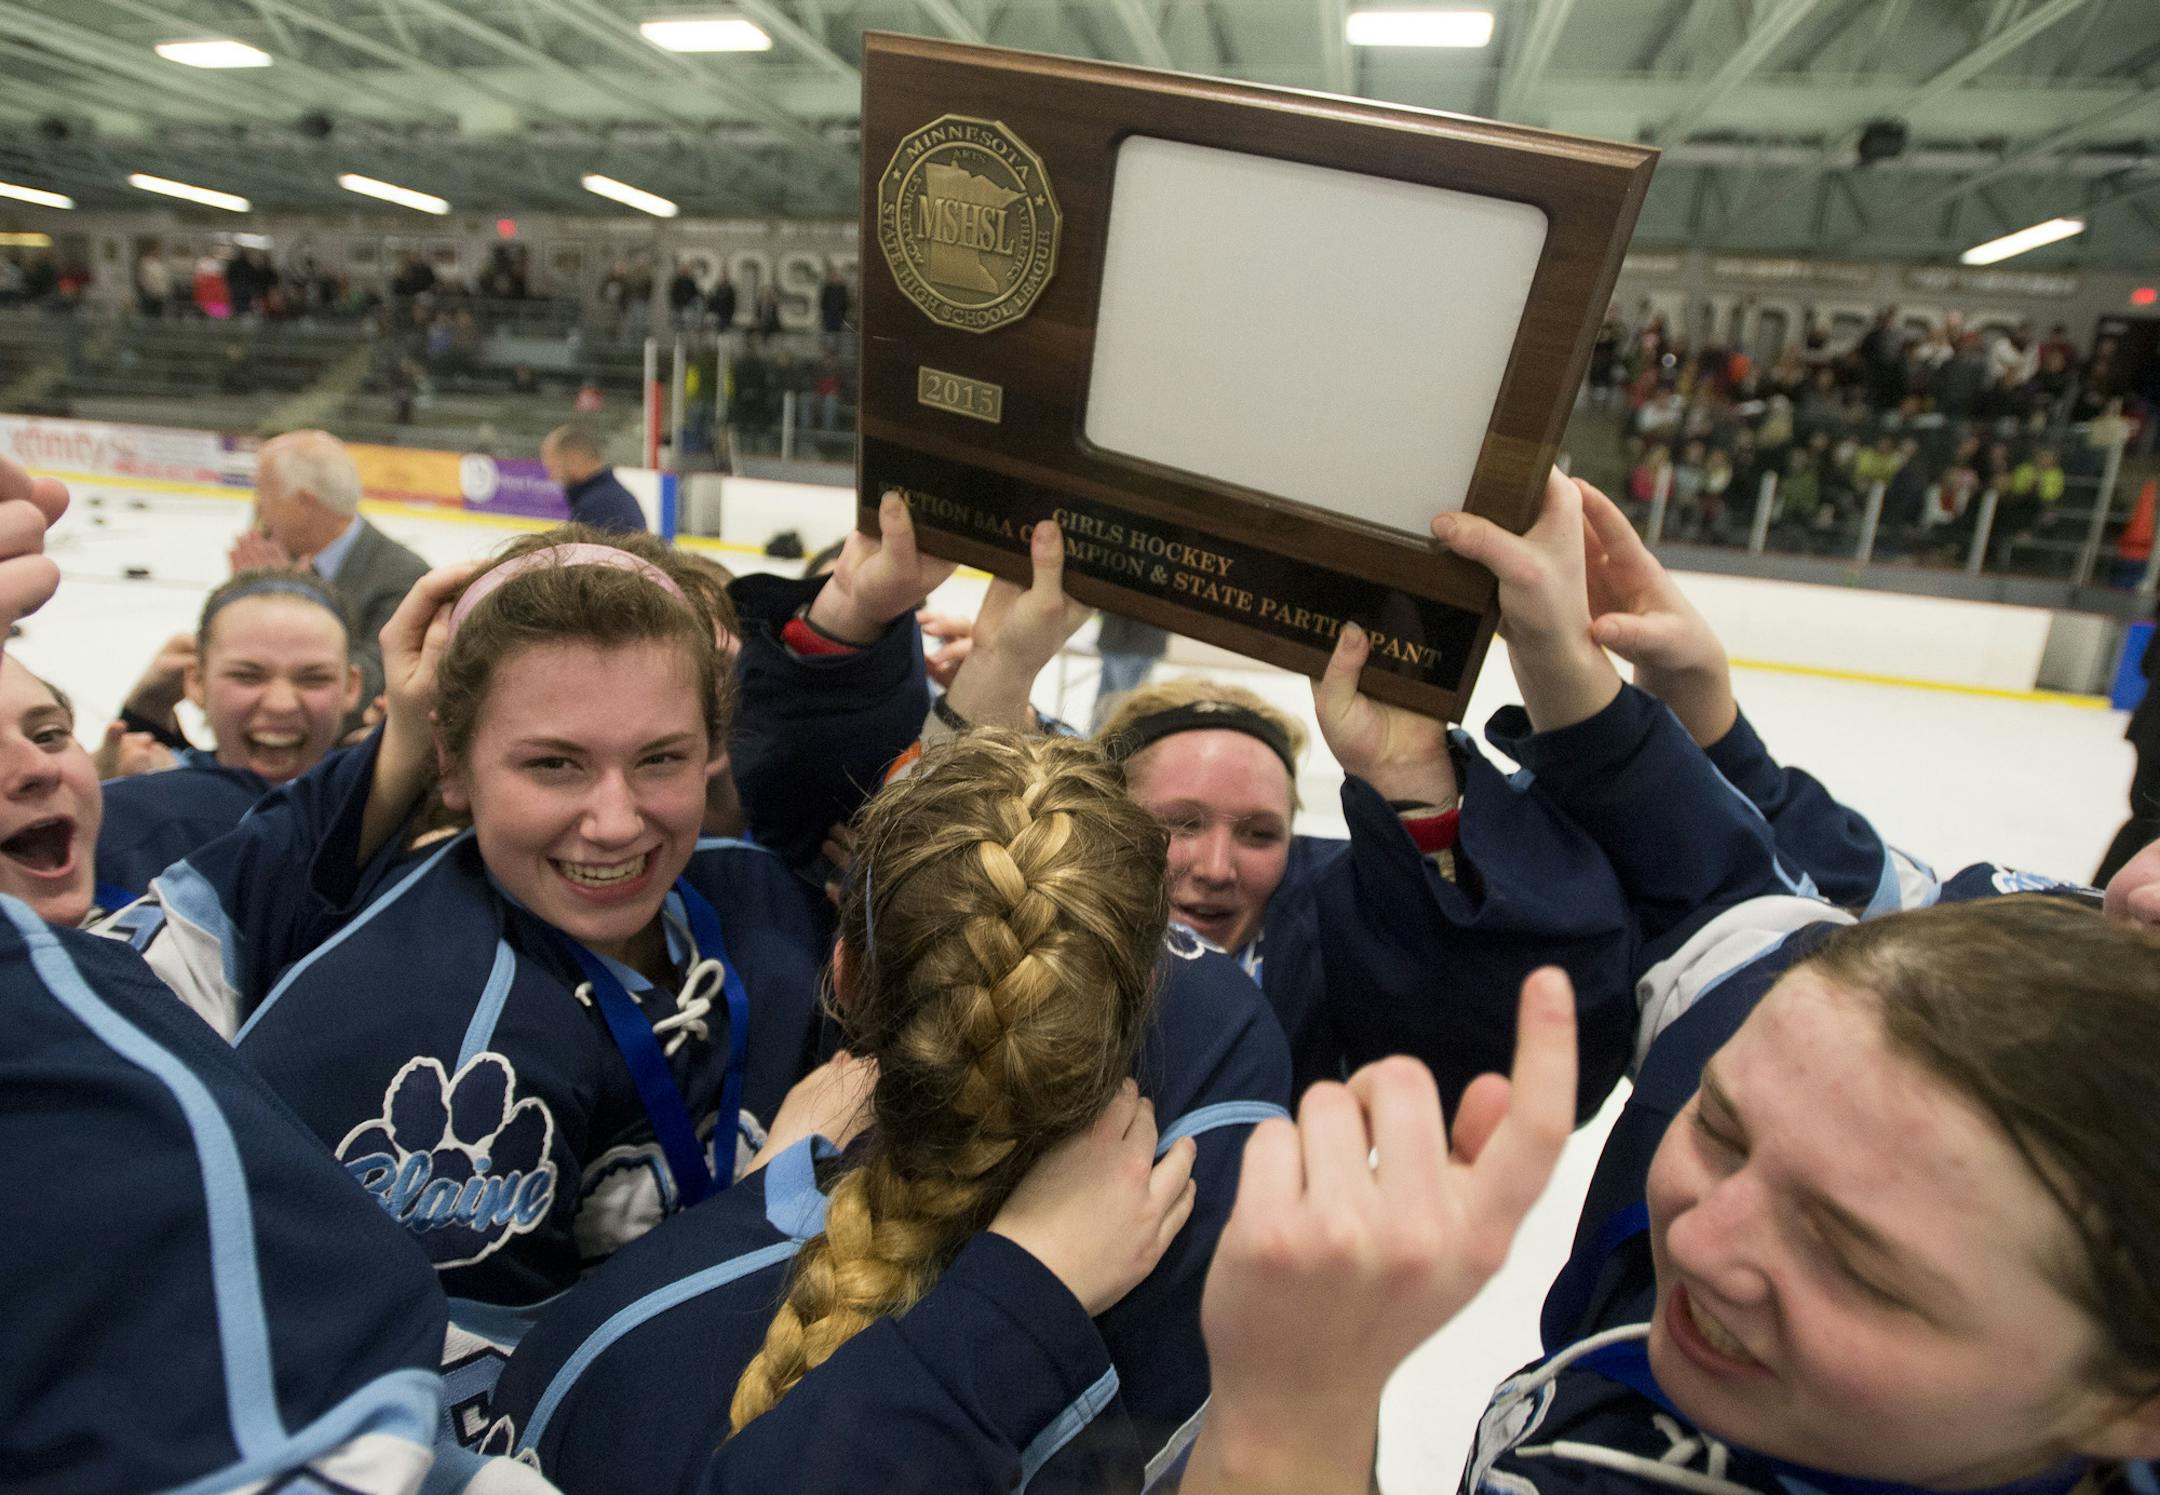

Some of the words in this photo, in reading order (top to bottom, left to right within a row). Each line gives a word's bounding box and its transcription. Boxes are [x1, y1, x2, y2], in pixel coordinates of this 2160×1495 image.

[905, 126, 1031, 181] MINNESOTA
[917, 194, 1015, 256] MSHSL
[882, 202, 901, 264] STATE
[900, 270, 939, 315] HIGH
[943, 306, 1015, 325] SCHOOL
[1017, 231, 1051, 307] LEAGUE
[925, 375, 993, 414] 2015
[880, 480, 970, 525] CTION
[1020, 523, 1145, 577] CMPION
[1150, 564, 1168, 585] &
[1173, 571, 1253, 611] STATE
[1258, 597, 1441, 668] PARTIPANT
[1052, 507, 1124, 544] GIRLS
[1129, 530, 1234, 577] HOCKEY
